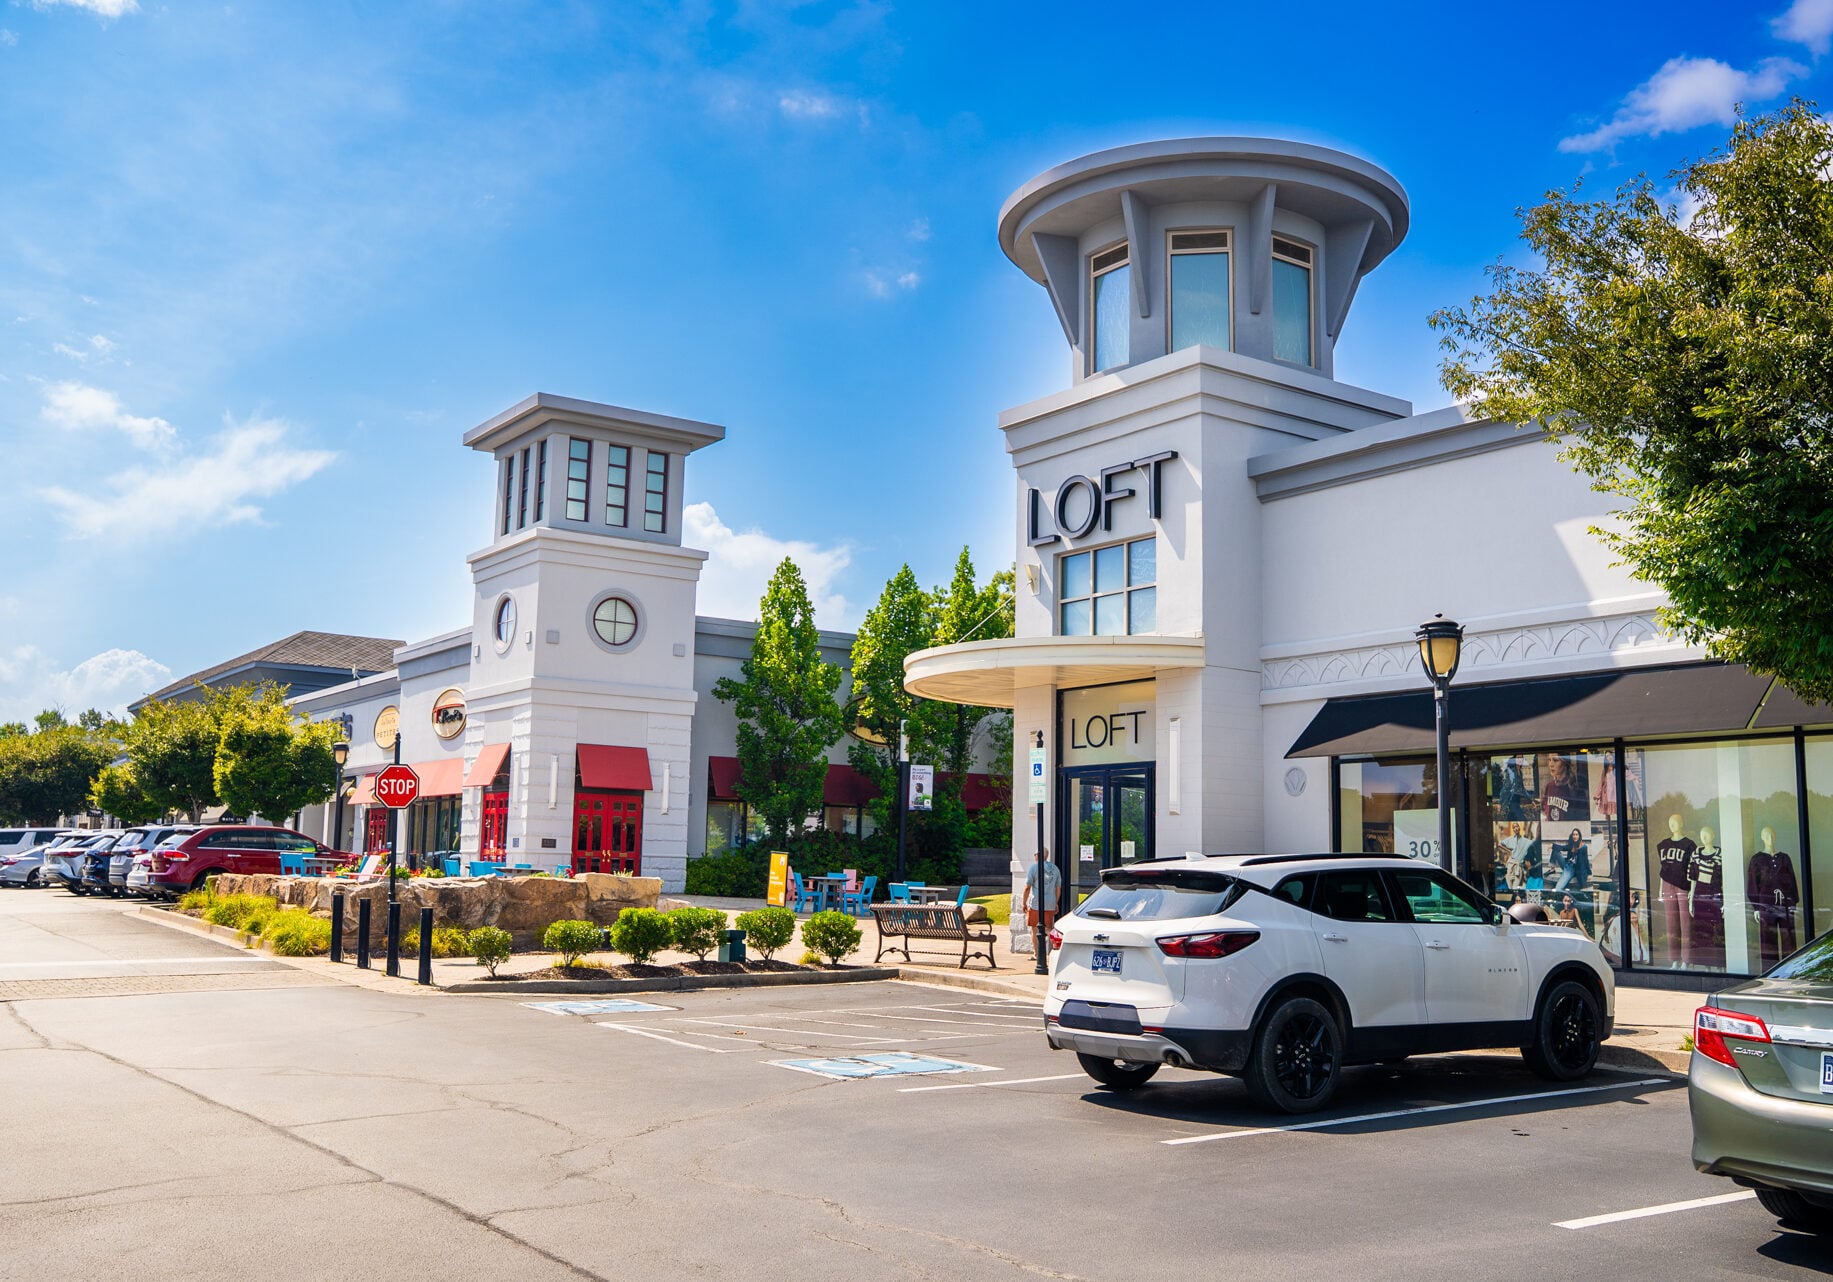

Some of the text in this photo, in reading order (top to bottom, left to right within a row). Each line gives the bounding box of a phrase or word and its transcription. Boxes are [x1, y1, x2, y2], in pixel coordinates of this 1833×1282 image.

[1027, 450, 1178, 547] LOFT
[1072, 710, 1146, 749] LOFT
[379, 778, 415, 795] STOP
[1409, 841, 1431, 858] 30
[1660, 847, 1685, 862] LOU
